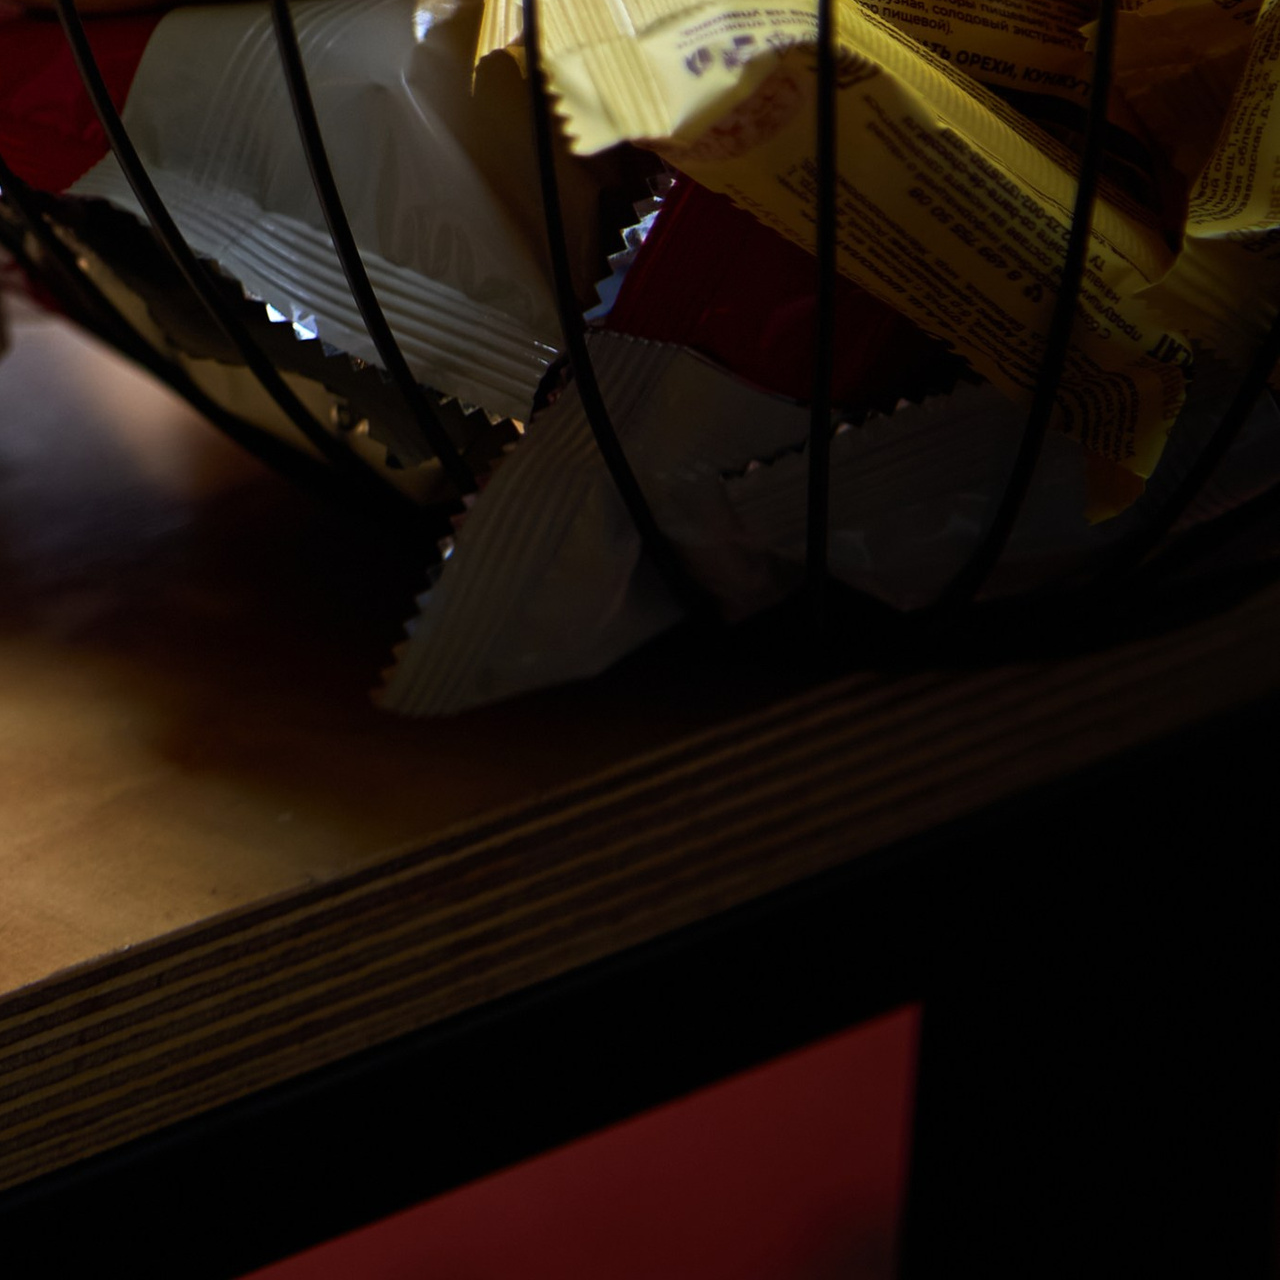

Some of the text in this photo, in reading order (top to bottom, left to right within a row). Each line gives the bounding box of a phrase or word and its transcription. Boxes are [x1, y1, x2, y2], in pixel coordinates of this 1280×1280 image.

[880, 5, 955, 36] пищевой).
[930, 2, 1011, 33] солодовый
[954, 48, 1019, 80] ОРЕХИ,
[1232, 99, 1249, 135] ком.
[1235, 96, 1262, 167] область,
[1227, 136, 1240, 148] 1,
[904, 159, 918, 174] о
[903, 181, 1024, 285] 8 499 755 50 08
[1004, 224, 1054, 268] составе
[1087, 251, 1109, 273] ТУ
[1103, 286, 1123, 305] на
[1098, 326, 1113, 341] С
